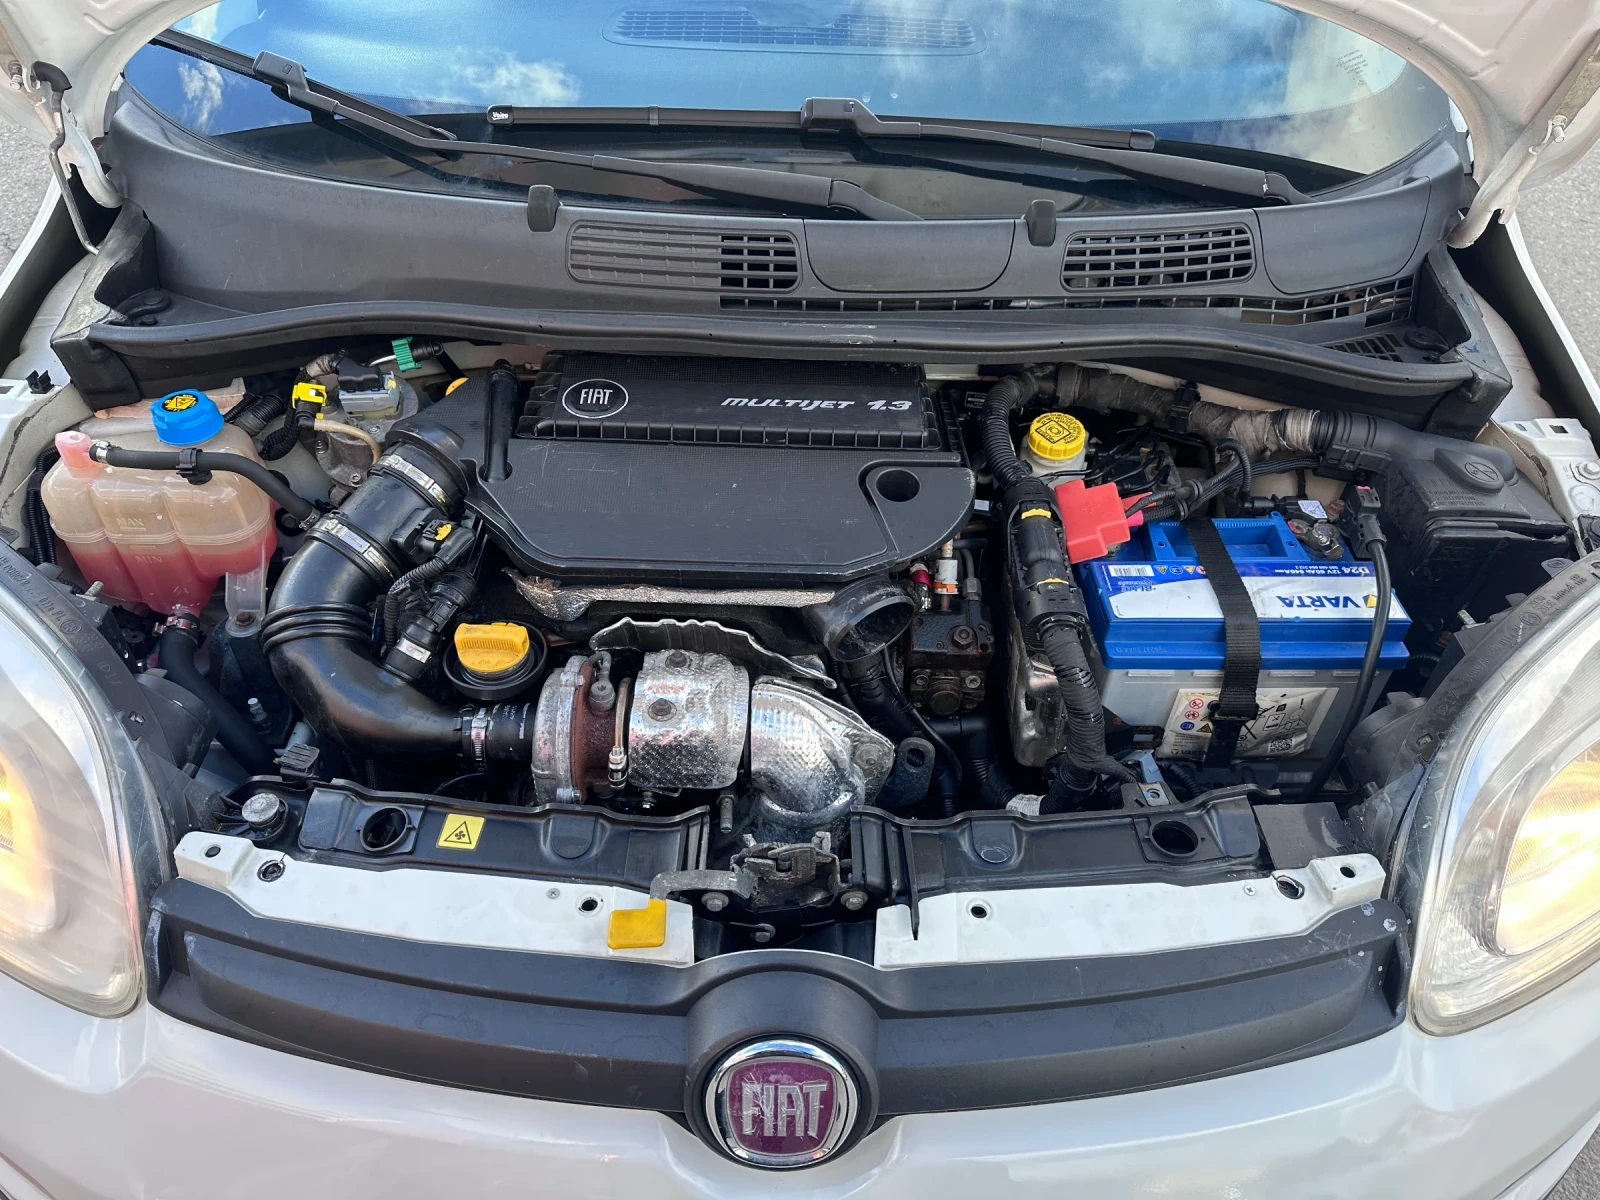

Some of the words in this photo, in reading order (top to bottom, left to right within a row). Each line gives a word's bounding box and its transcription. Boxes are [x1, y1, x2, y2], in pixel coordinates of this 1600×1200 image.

[492, 111, 509, 120] Valeo
[580, 388, 613, 404] FIAT
[866, 399, 912, 411] 1.3
[116, 517, 144, 527] MAX
[135, 555, 163, 564] MIN
[1276, 595, 1361, 608] VARTA
[741, 1081, 829, 1139] FIAT
